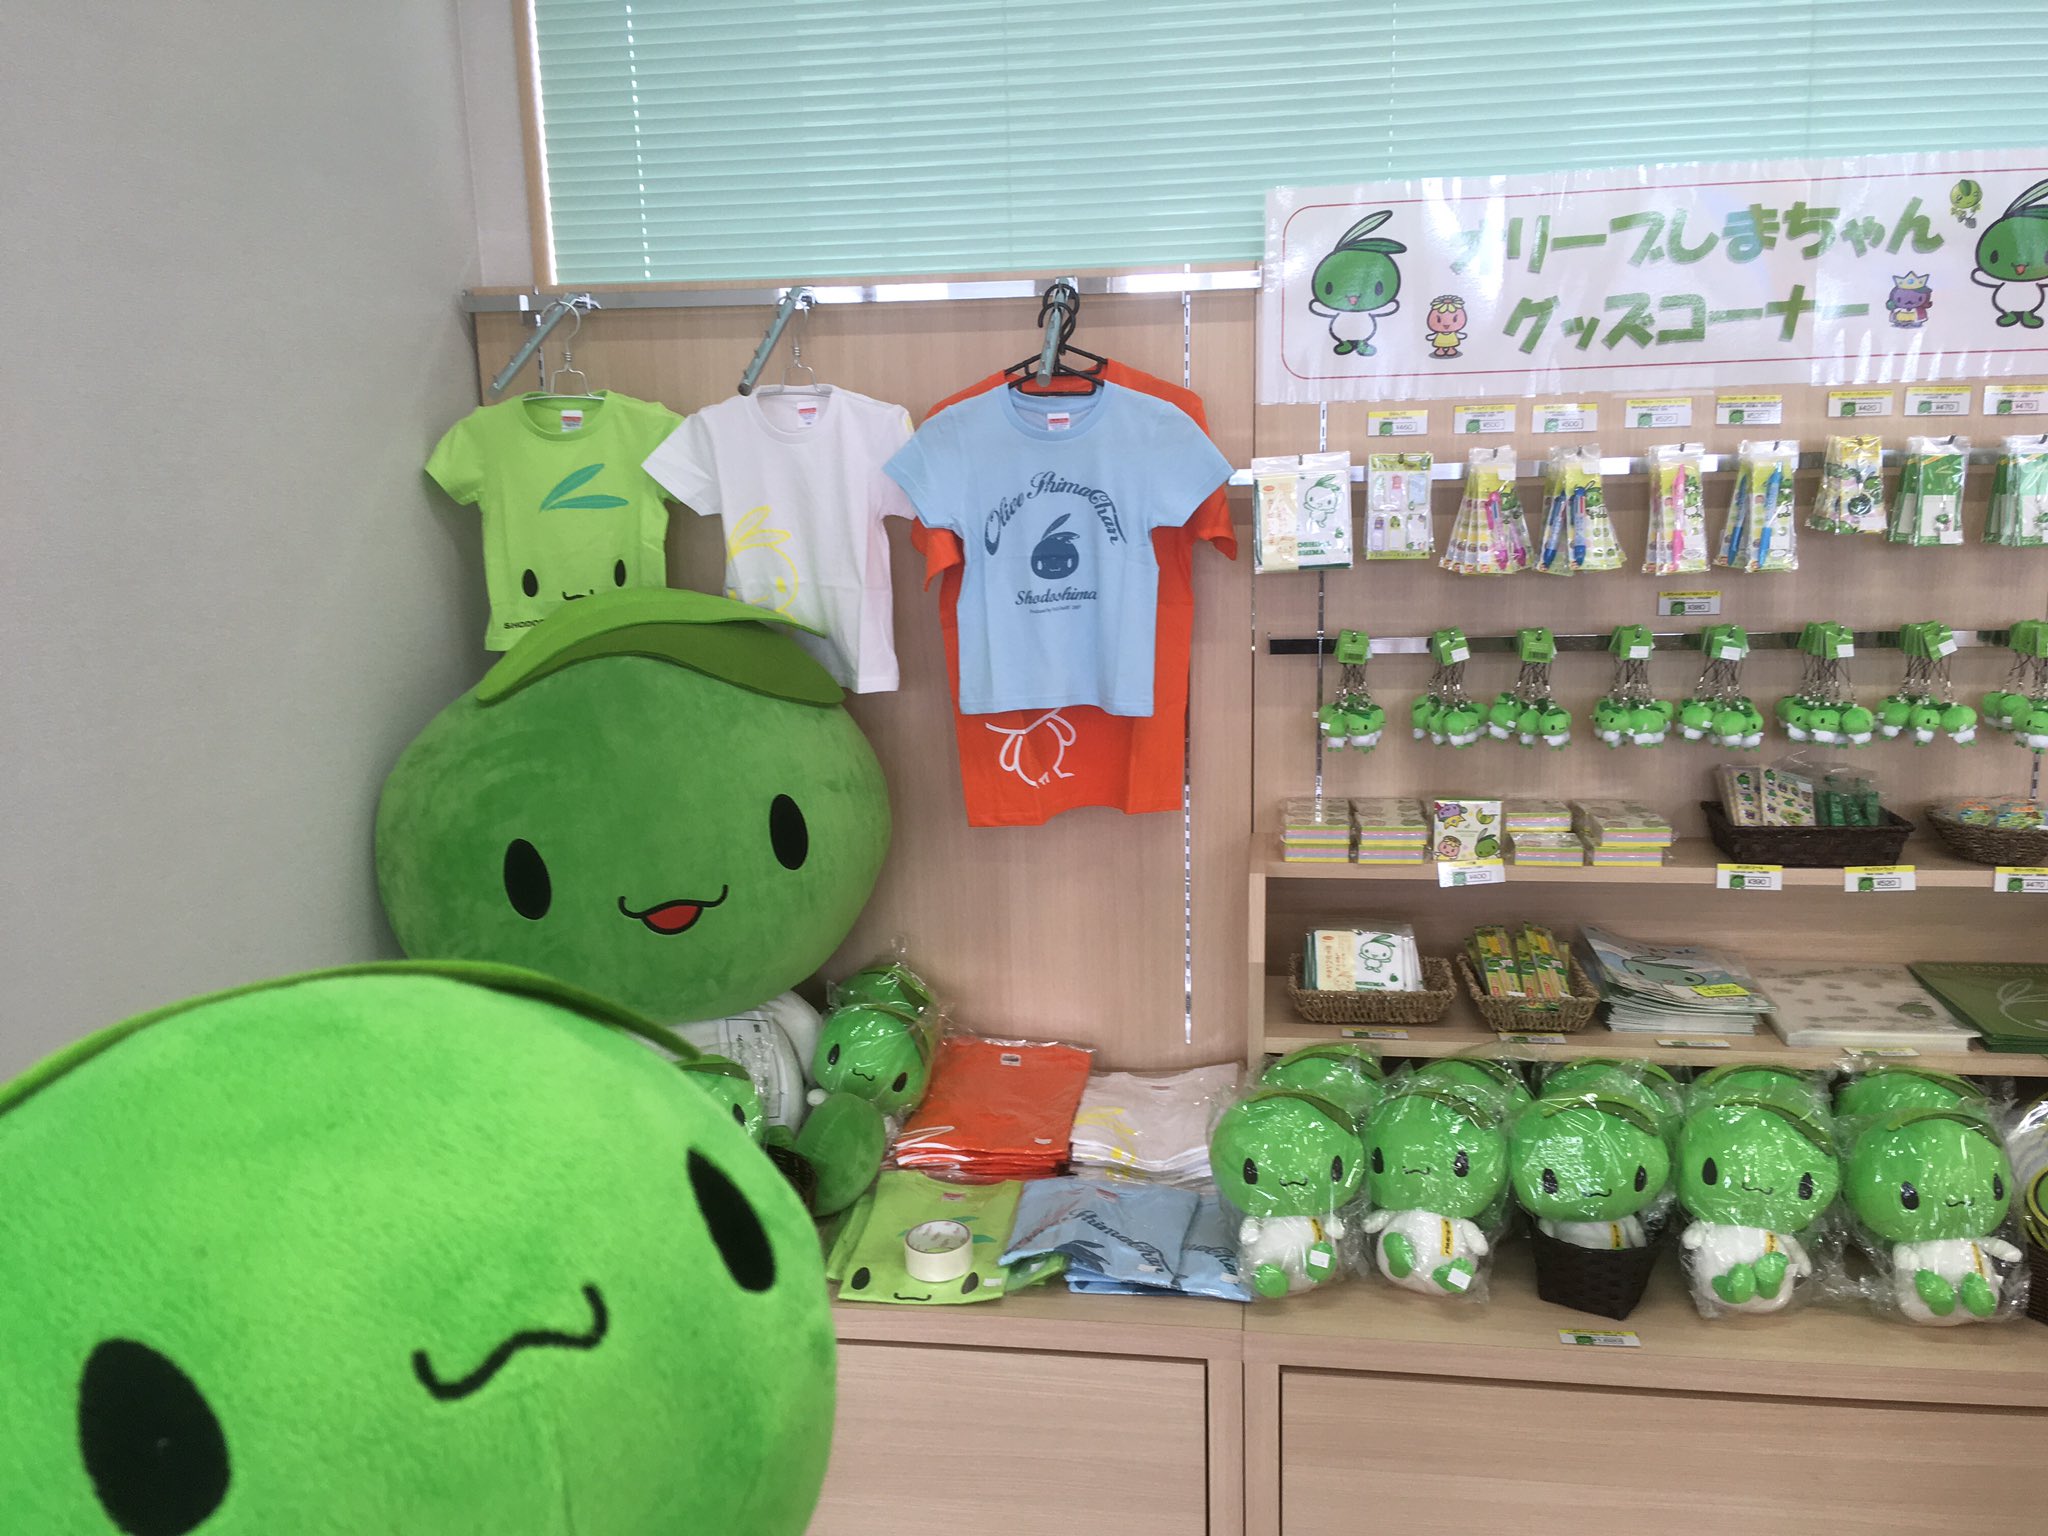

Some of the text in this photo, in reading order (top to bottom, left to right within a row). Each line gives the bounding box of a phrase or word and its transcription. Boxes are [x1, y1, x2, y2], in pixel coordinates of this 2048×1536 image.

[1502, 284, 1869, 354] グッズコーナー
[984, 492, 1025, 556] Olive
[1014, 586, 1098, 605] Shodoshima
